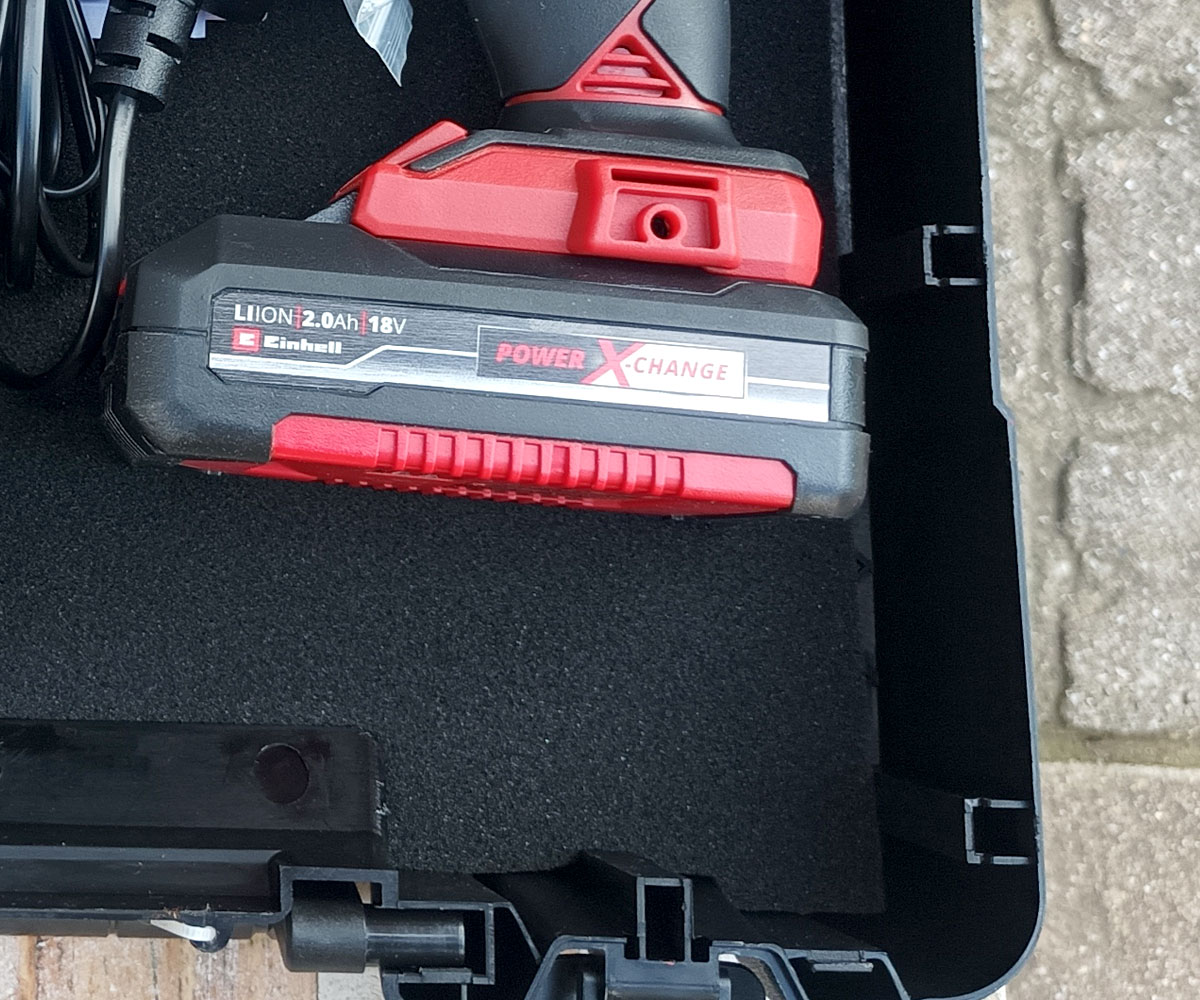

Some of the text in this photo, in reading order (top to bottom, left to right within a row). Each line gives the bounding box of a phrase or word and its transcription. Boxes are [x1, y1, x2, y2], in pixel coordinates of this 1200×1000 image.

[302, 311, 359, 331] 2.0Ah
[368, 315, 407, 335] 18V
[264, 335, 342, 354] Einhell
[495, 341, 586, 370] POWER
